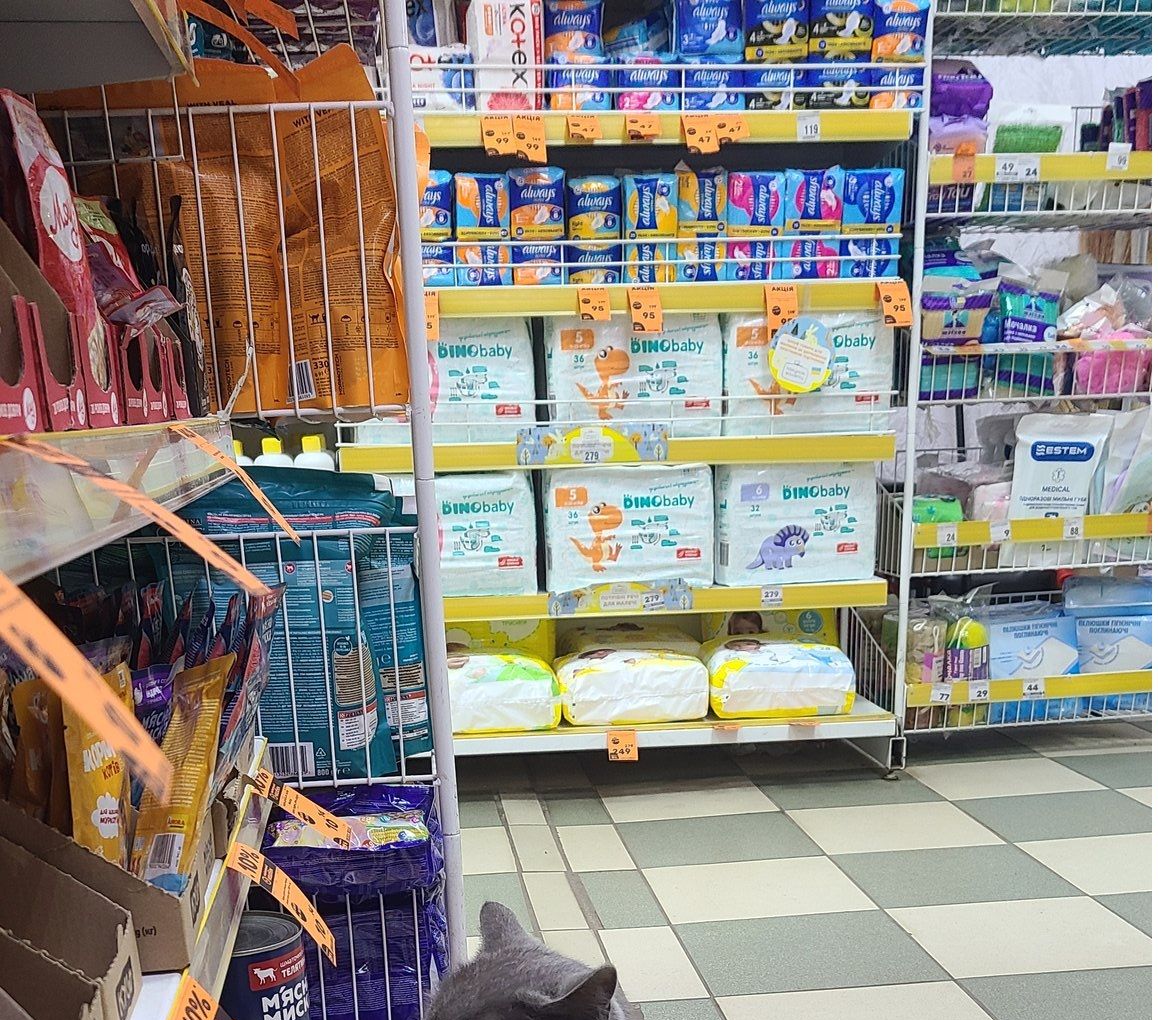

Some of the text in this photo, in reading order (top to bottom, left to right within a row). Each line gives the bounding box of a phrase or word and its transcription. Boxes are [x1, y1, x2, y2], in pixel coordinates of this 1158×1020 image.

[692, 2, 729, 19] always
[762, 1, 797, 16] always
[553, 11, 591, 28] always
[885, 12, 921, 30] always
[630, 69, 669, 84] always
[692, 69, 730, 84] always
[804, 124, 818, 134] 119
[1002, 163, 1014, 171] 49
[1025, 168, 1037, 176] 24
[521, 187, 556, 200] always
[700, 179, 712, 221] always
[807, 176, 818, 216] always
[484, 184, 494, 225] always
[577, 196, 613, 208] always
[642, 185, 651, 226] always
[756, 185, 767, 224] always
[870, 180, 881, 222] always
[893, 304, 906, 312] 95
[574, 355, 584, 363] 36
[585, 452, 599, 461] 279
[569, 489, 577, 500] 5
[568, 511, 578, 519] 36
[1070, 527, 1079, 535] 88
[947, 534, 955, 542] 24
[612, 747, 631, 756] 249
